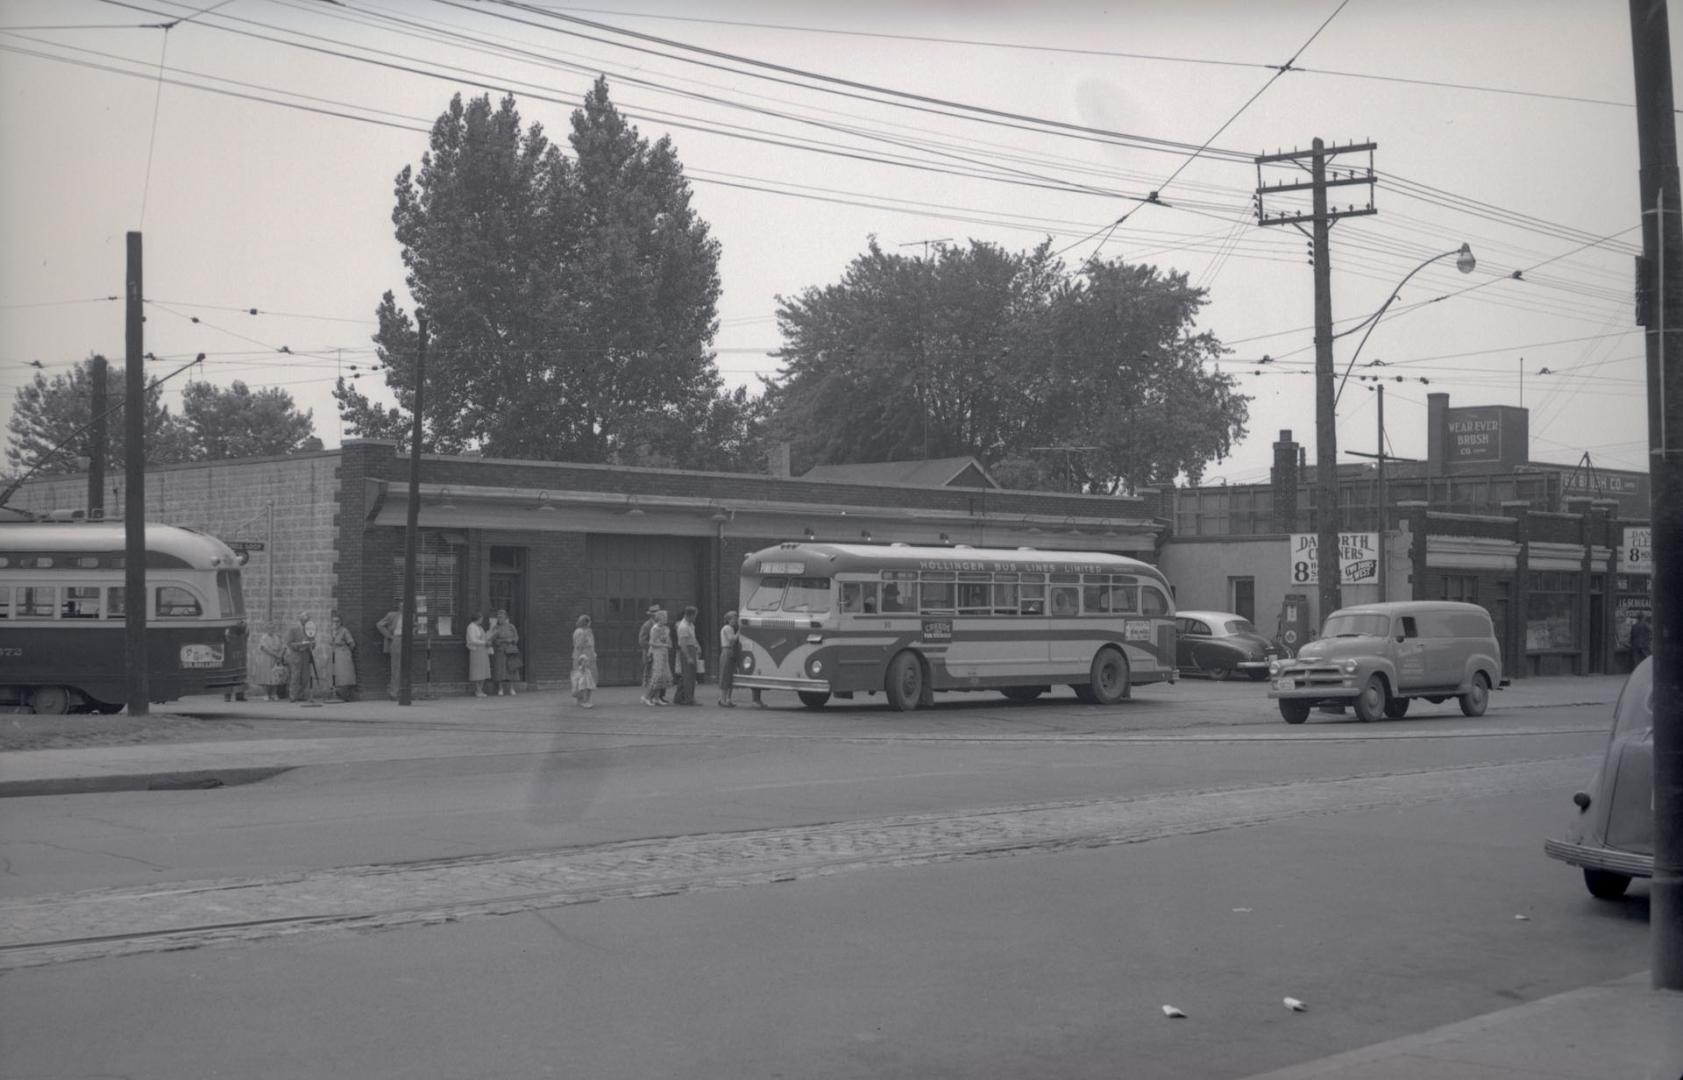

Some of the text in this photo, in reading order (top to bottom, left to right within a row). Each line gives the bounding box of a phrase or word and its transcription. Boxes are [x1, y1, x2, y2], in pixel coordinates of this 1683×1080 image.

[1457, 434, 1489, 445] BRUSH
[1630, 548, 1640, 562] 8
[920, 560, 985, 571] HOLLINGER
[994, 562, 1017, 572] BUS
[1025, 563, 1056, 573] LINES
[1064, 563, 1102, 574] LIMITED
[1294, 561, 1309, 582] 8
